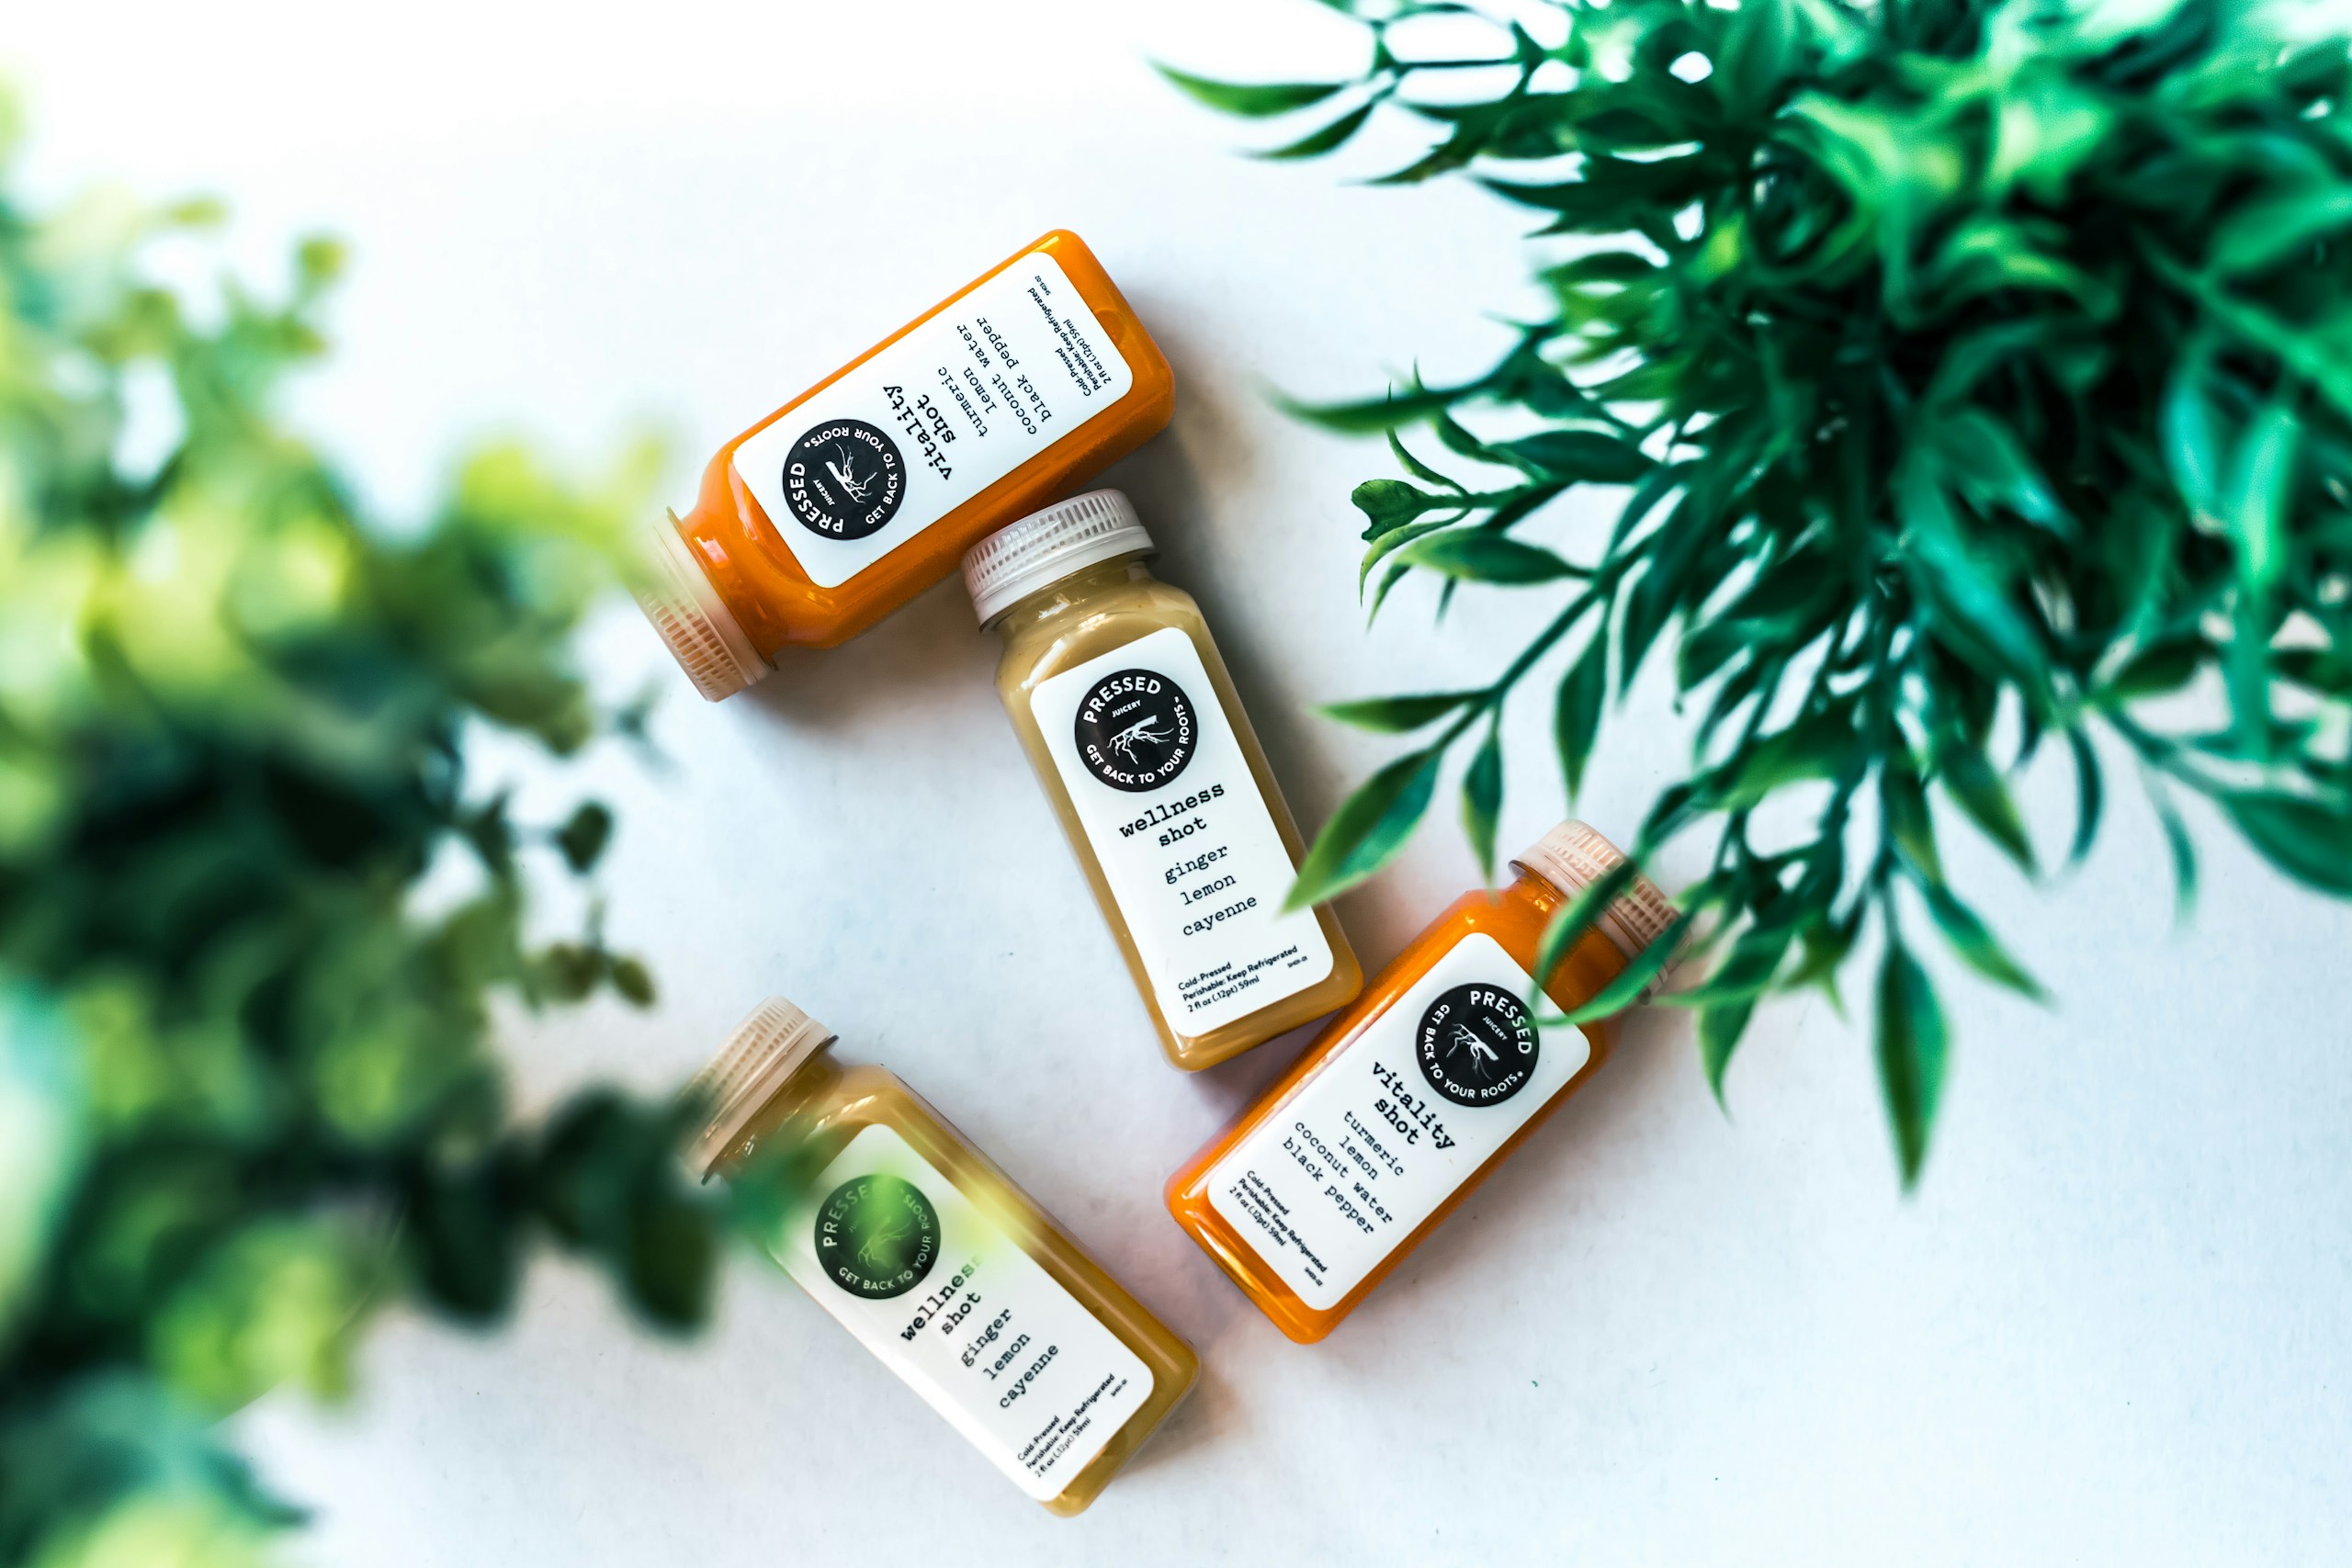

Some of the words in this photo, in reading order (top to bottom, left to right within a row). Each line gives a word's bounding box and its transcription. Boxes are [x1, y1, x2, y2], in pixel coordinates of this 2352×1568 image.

[1026, 288, 1062, 333] Refrigerated
[1062, 319, 1080, 340] 59ml
[956, 324, 990, 368] water
[976, 317, 1020, 370] pepper
[1059, 332, 1075, 353] Keep
[1055, 347, 1091, 397] Cold-Pressed
[1072, 350, 1102, 391] Perishable:
[1093, 360, 1102, 371] oz
[1098, 369, 1107, 378] fl
[1102, 376, 1112, 385] 2
[937, 367, 988, 437] turmeric
[963, 367, 998, 414] lemon
[991, 373, 1037, 435] coconut
[1016, 374, 1052, 423] black
[854, 428, 885, 453] YOUR
[882, 386, 953, 480] vitality
[917, 394, 956, 444] shot
[882, 452, 896, 470] TO
[789, 462, 844, 533] PRESSED
[812, 479, 836, 506] JUICERY
[882, 472, 899, 505] BACK
[865, 504, 886, 525] GET
[1083, 676, 1161, 724] PRESSED
[1112, 699, 1141, 718] JUICERY
[1086, 744, 1105, 766] GET
[1102, 764, 1135, 784] BACK
[1137, 772, 1156, 784] TO
[1156, 748, 1185, 777] YOUR
[1118, 784, 1225, 838] wellness
[1159, 817, 1207, 848] shot
[1164, 845, 1227, 885] ginger
[1180, 874, 1237, 906] lemon
[1182, 897, 1257, 936] cayenne
[1178, 961, 1232, 991] Cold-Pressed
[1182, 978, 1227, 1002] Perishable:
[1226, 969, 1248, 982] Keep
[1247, 944, 1298, 973] Refrigerated
[1187, 1004, 1194, 1013] 2
[1193, 1000, 1202, 1010] fl
[1202, 998, 1212, 1007] oz
[1238, 975, 1261, 990] 59ml
[1431, 1004, 1451, 1025] GET
[1470, 990, 1532, 1054] PRESSED
[1482, 1015, 1508, 1041] JUICERY
[1423, 1027, 1437, 1060] BACK
[1429, 1062, 1444, 1079] TO
[1443, 1077, 1476, 1099] YOUR
[1373, 1061, 1456, 1149] vitality
[1374, 1099, 1419, 1145] shot
[1339, 1135, 1378, 1180] lemon
[1343, 1111, 1404, 1177] turmeric
[1247, 1170, 1291, 1216] Cold-Pressed
[1282, 1136, 1324, 1182] black
[1324, 1185, 1374, 1234] pepper
[1295, 1122, 1349, 1179] coconut
[1352, 1181, 1393, 1224] water
[822, 1181, 873, 1247] PRESSE
[1228, 1186, 1238, 1194] 2
[1235, 1191, 1243, 1200] fl
[1239, 1199, 1250, 1209] oz
[1268, 1226, 1287, 1247] 59ml
[1238, 1178, 1272, 1215] Perishable:
[1271, 1212, 1288, 1232] Keep
[1286, 1229, 1328, 1273] Refrigerated
[839, 1267, 860, 1285] GET
[863, 1279, 896, 1291] BACK
[897, 1269, 913, 1283] TO
[912, 1235, 932, 1269] YOUR
[941, 1292, 981, 1336] shot
[961, 1308, 1012, 1368] ginger
[982, 1334, 1031, 1381] lemon
[1000, 1345, 1058, 1409] cayenne
[1017, 1415, 1060, 1461] Cold-Pressed
[1025, 1435, 1059, 1470] Perishable:
[1058, 1416, 1077, 1435] Keep
[1073, 1372, 1115, 1417] Refrigerated
[1071, 1416, 1091, 1437] 59ml
